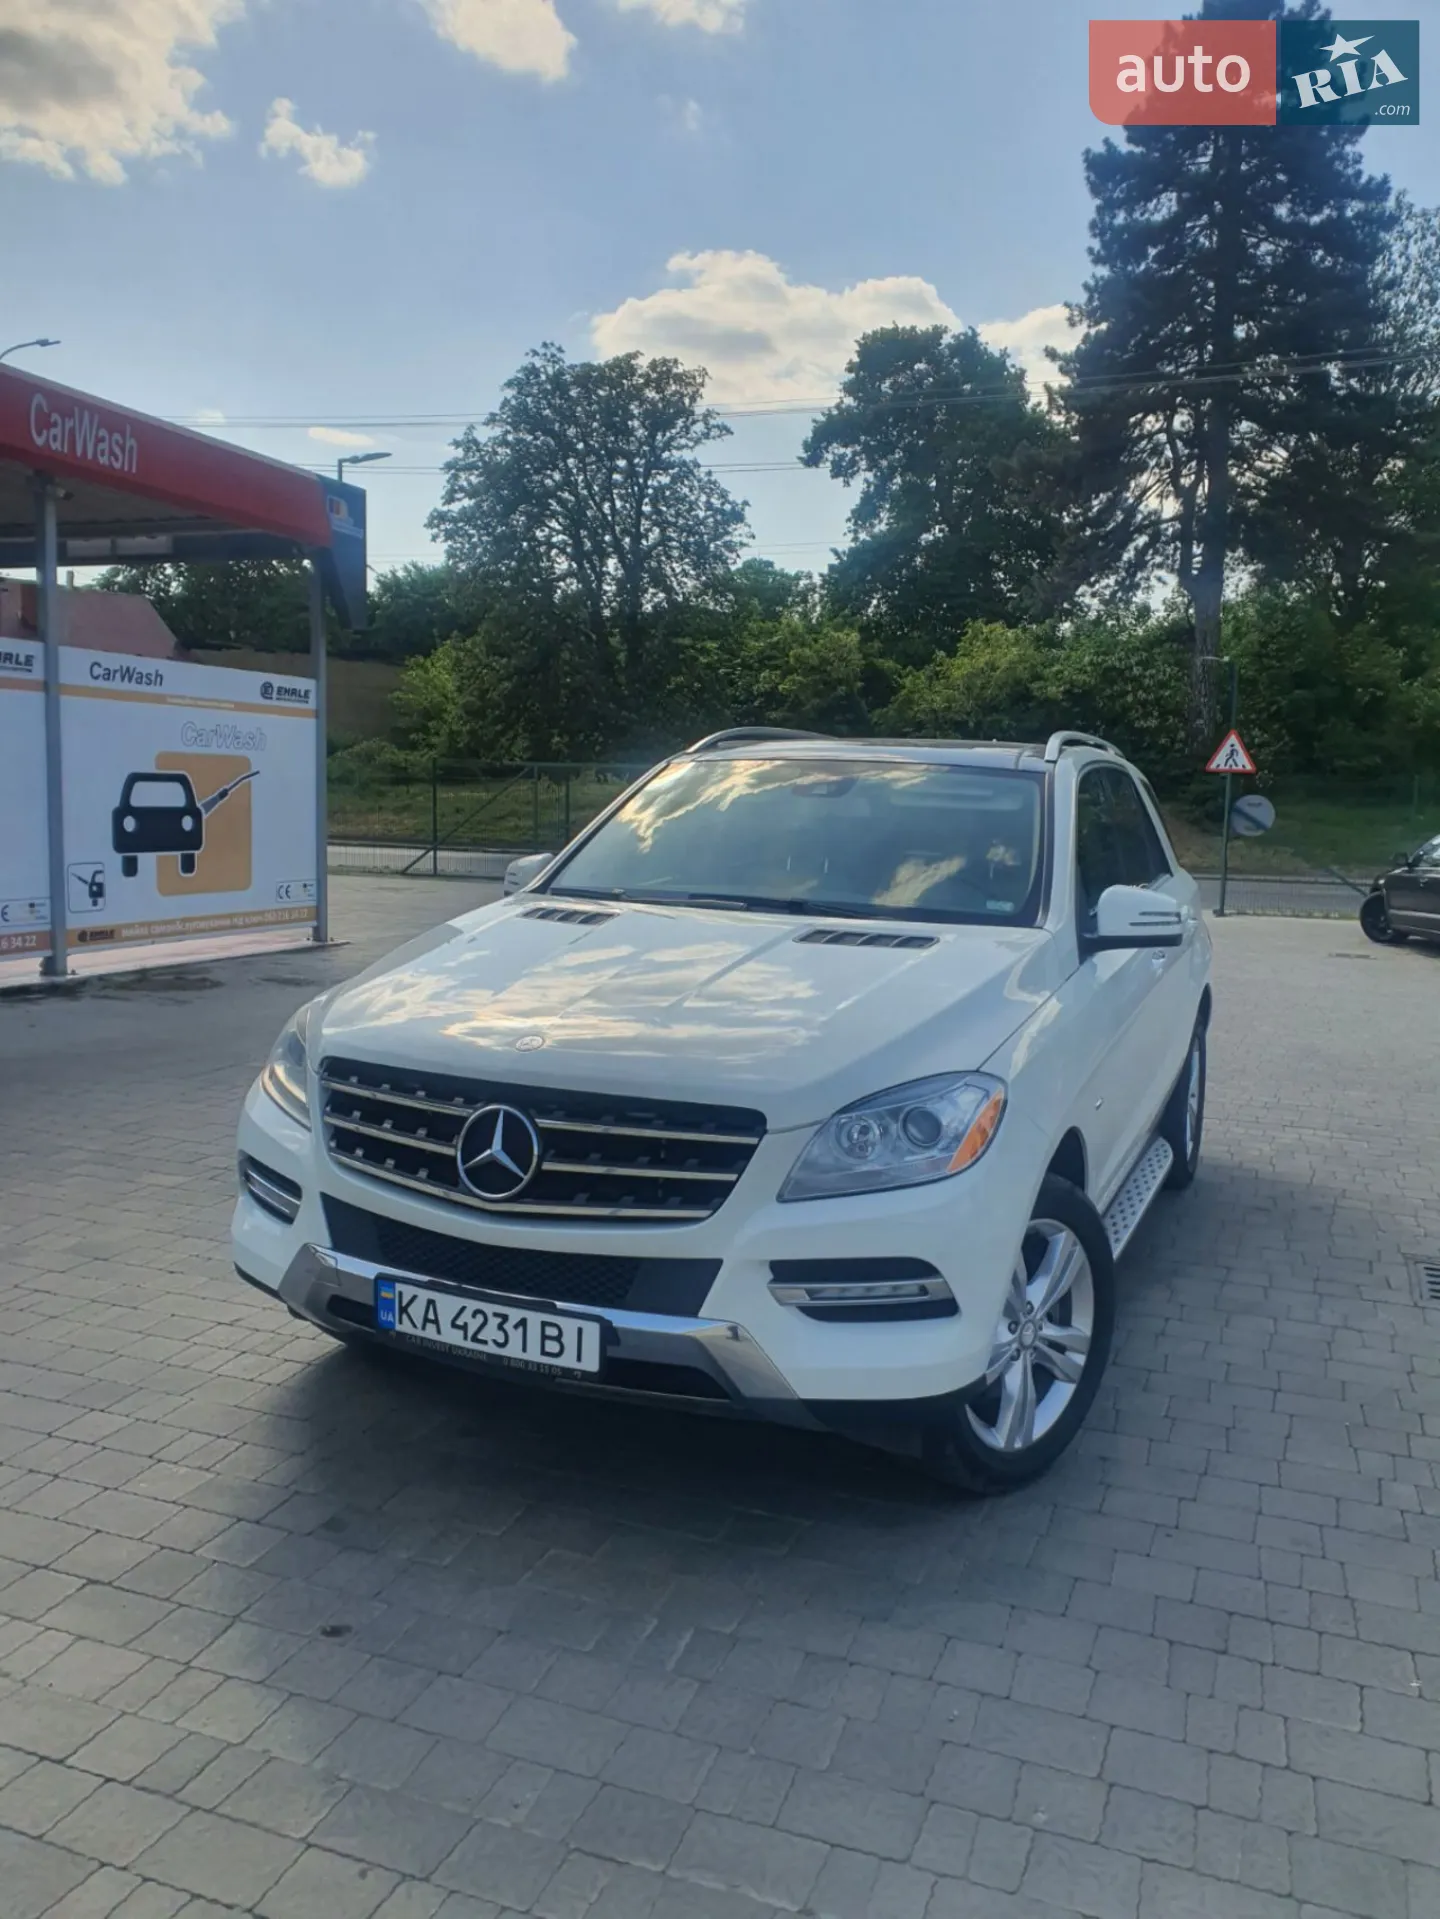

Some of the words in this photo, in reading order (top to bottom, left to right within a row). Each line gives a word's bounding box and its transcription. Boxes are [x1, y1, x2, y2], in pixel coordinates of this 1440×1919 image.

[30, 393, 138, 473] CarWash
[0, 650, 35, 667] RLE
[89, 661, 164, 687] CarWash
[181, 720, 267, 751] CarWash
[380, 1309, 394, 1323] UA
[397, 1290, 442, 1336] KA
[451, 1305, 528, 1354] 4231
[540, 1320, 583, 1363] BI
